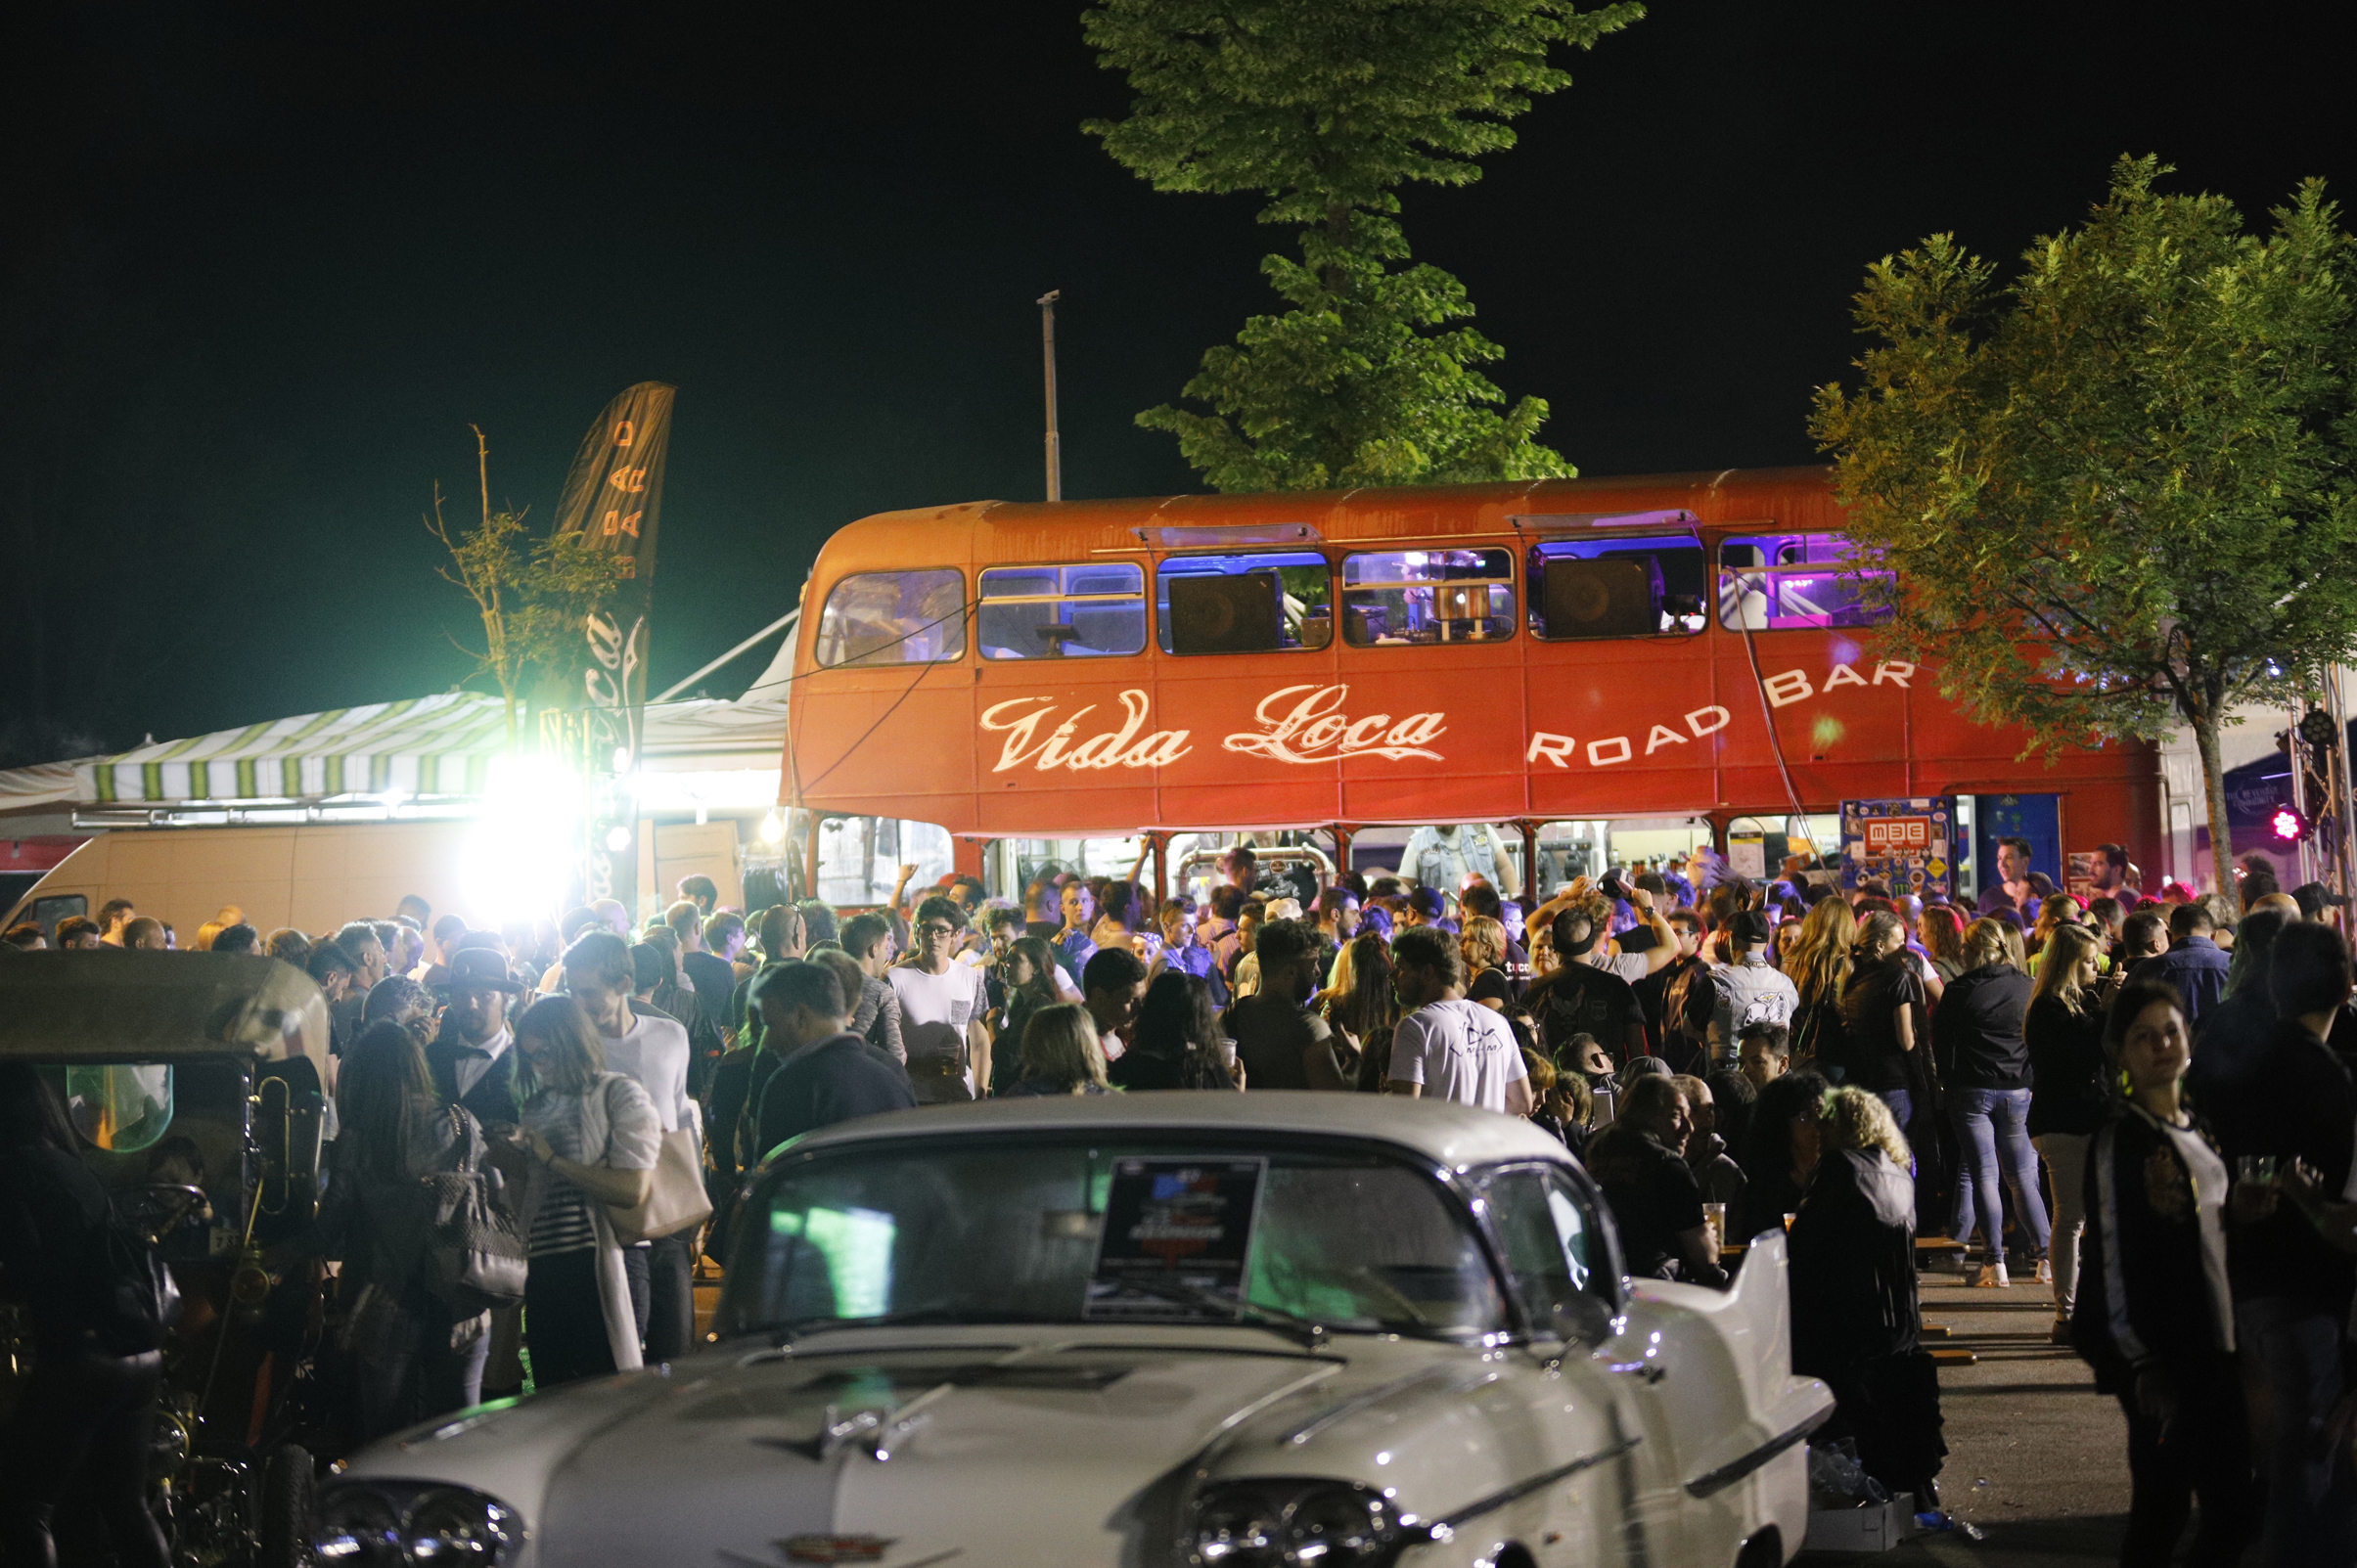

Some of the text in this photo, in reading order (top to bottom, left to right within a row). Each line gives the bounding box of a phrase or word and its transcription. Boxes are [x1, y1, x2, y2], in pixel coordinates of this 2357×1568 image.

[603, 421, 634, 536] OAD
[979, 683, 1448, 773] Vida Loca
[1526, 660, 1916, 769] ROAD BAR
